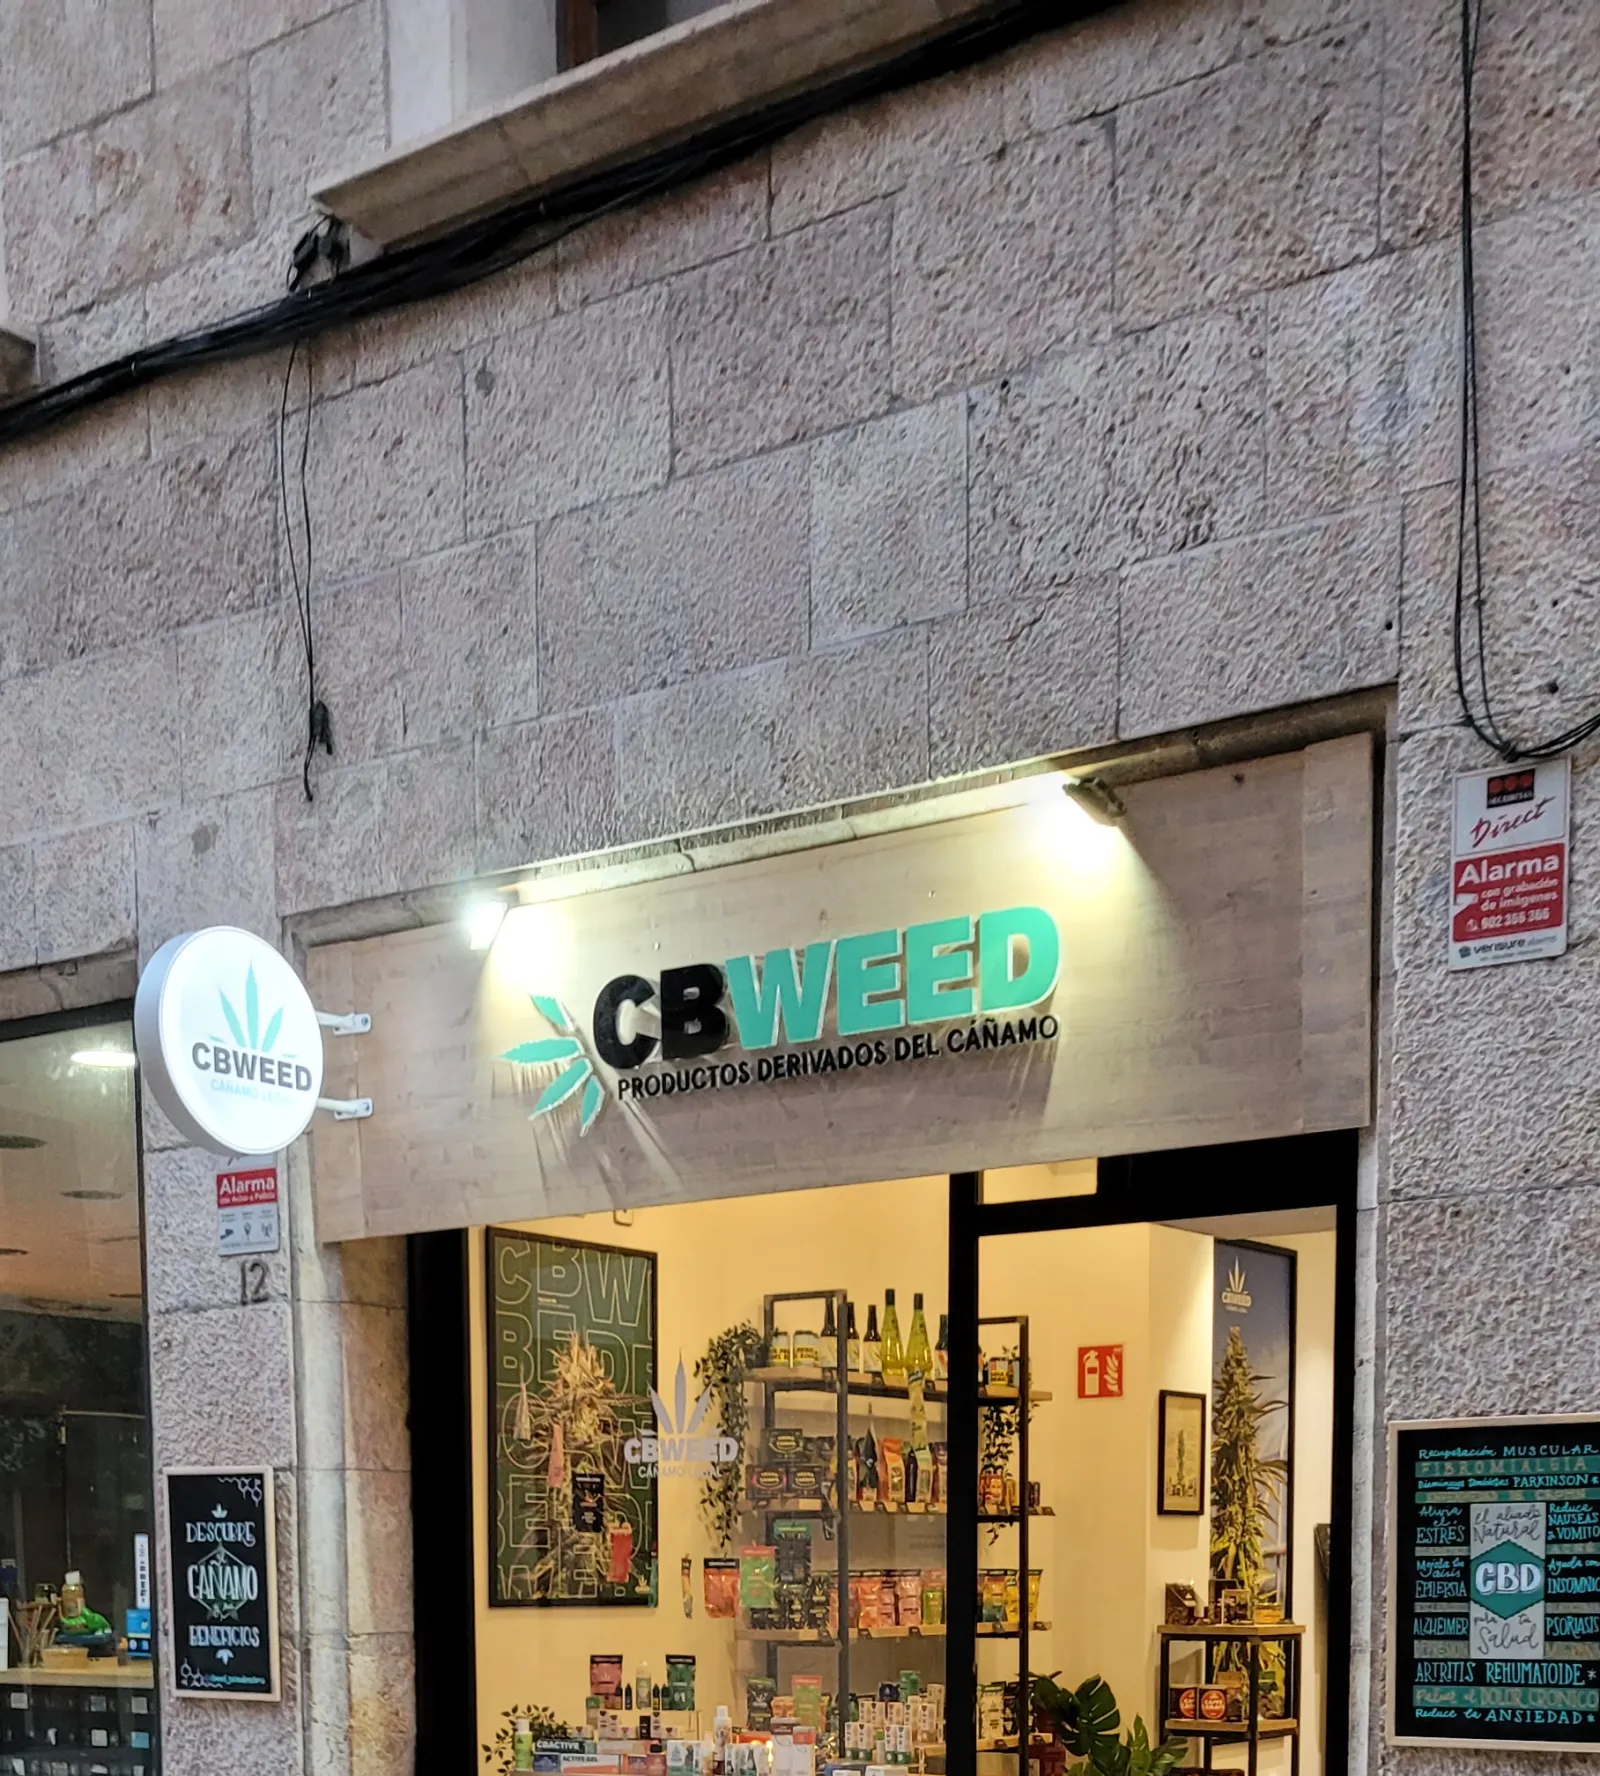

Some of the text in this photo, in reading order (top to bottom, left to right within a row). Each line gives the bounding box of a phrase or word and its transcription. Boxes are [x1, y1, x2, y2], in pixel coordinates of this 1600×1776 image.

[1470, 796, 1556, 848] Direct
[1458, 855, 1560, 887] Alarma
[1480, 899, 1498, 912] de
[593, 906, 1060, 1069] CBWEED
[192, 1042, 312, 1092] CBWEED
[618, 1014, 1059, 1100] PRODUCTOS DERIVADOS DEL CÁÑAMO
[219, 1175, 275, 1196] Alarma
[240, 1259, 269, 1304] 12
[624, 1437, 739, 1463] CBWEED
[1503, 1444, 1599, 1457] MUSCULAR
[1420, 1457, 1588, 1476] FIBROMIALGIA
[1512, 1474, 1588, 1488] PARKINSON
[1549, 1501, 1593, 1513] Reduce
[1547, 1512, 1599, 1526] NAUSEAS
[186, 1522, 256, 1547] DESCUBRE
[1415, 1580, 1467, 1598] EPILEPSIA
[1475, 1561, 1542, 1595] CBD
[189, 1625, 260, 1647] BENEFICIOS
[1413, 1617, 1469, 1636] ALZHEIMER
[1546, 1616, 1599, 1638] PSORIASIS
[1478, 1623, 1539, 1655] Salud
[1415, 1661, 1585, 1685] ARTRITIS REHUMATOIDE
[1416, 1707, 1457, 1719] Reduce
[1485, 1708, 1583, 1725] ANSIEDAD
